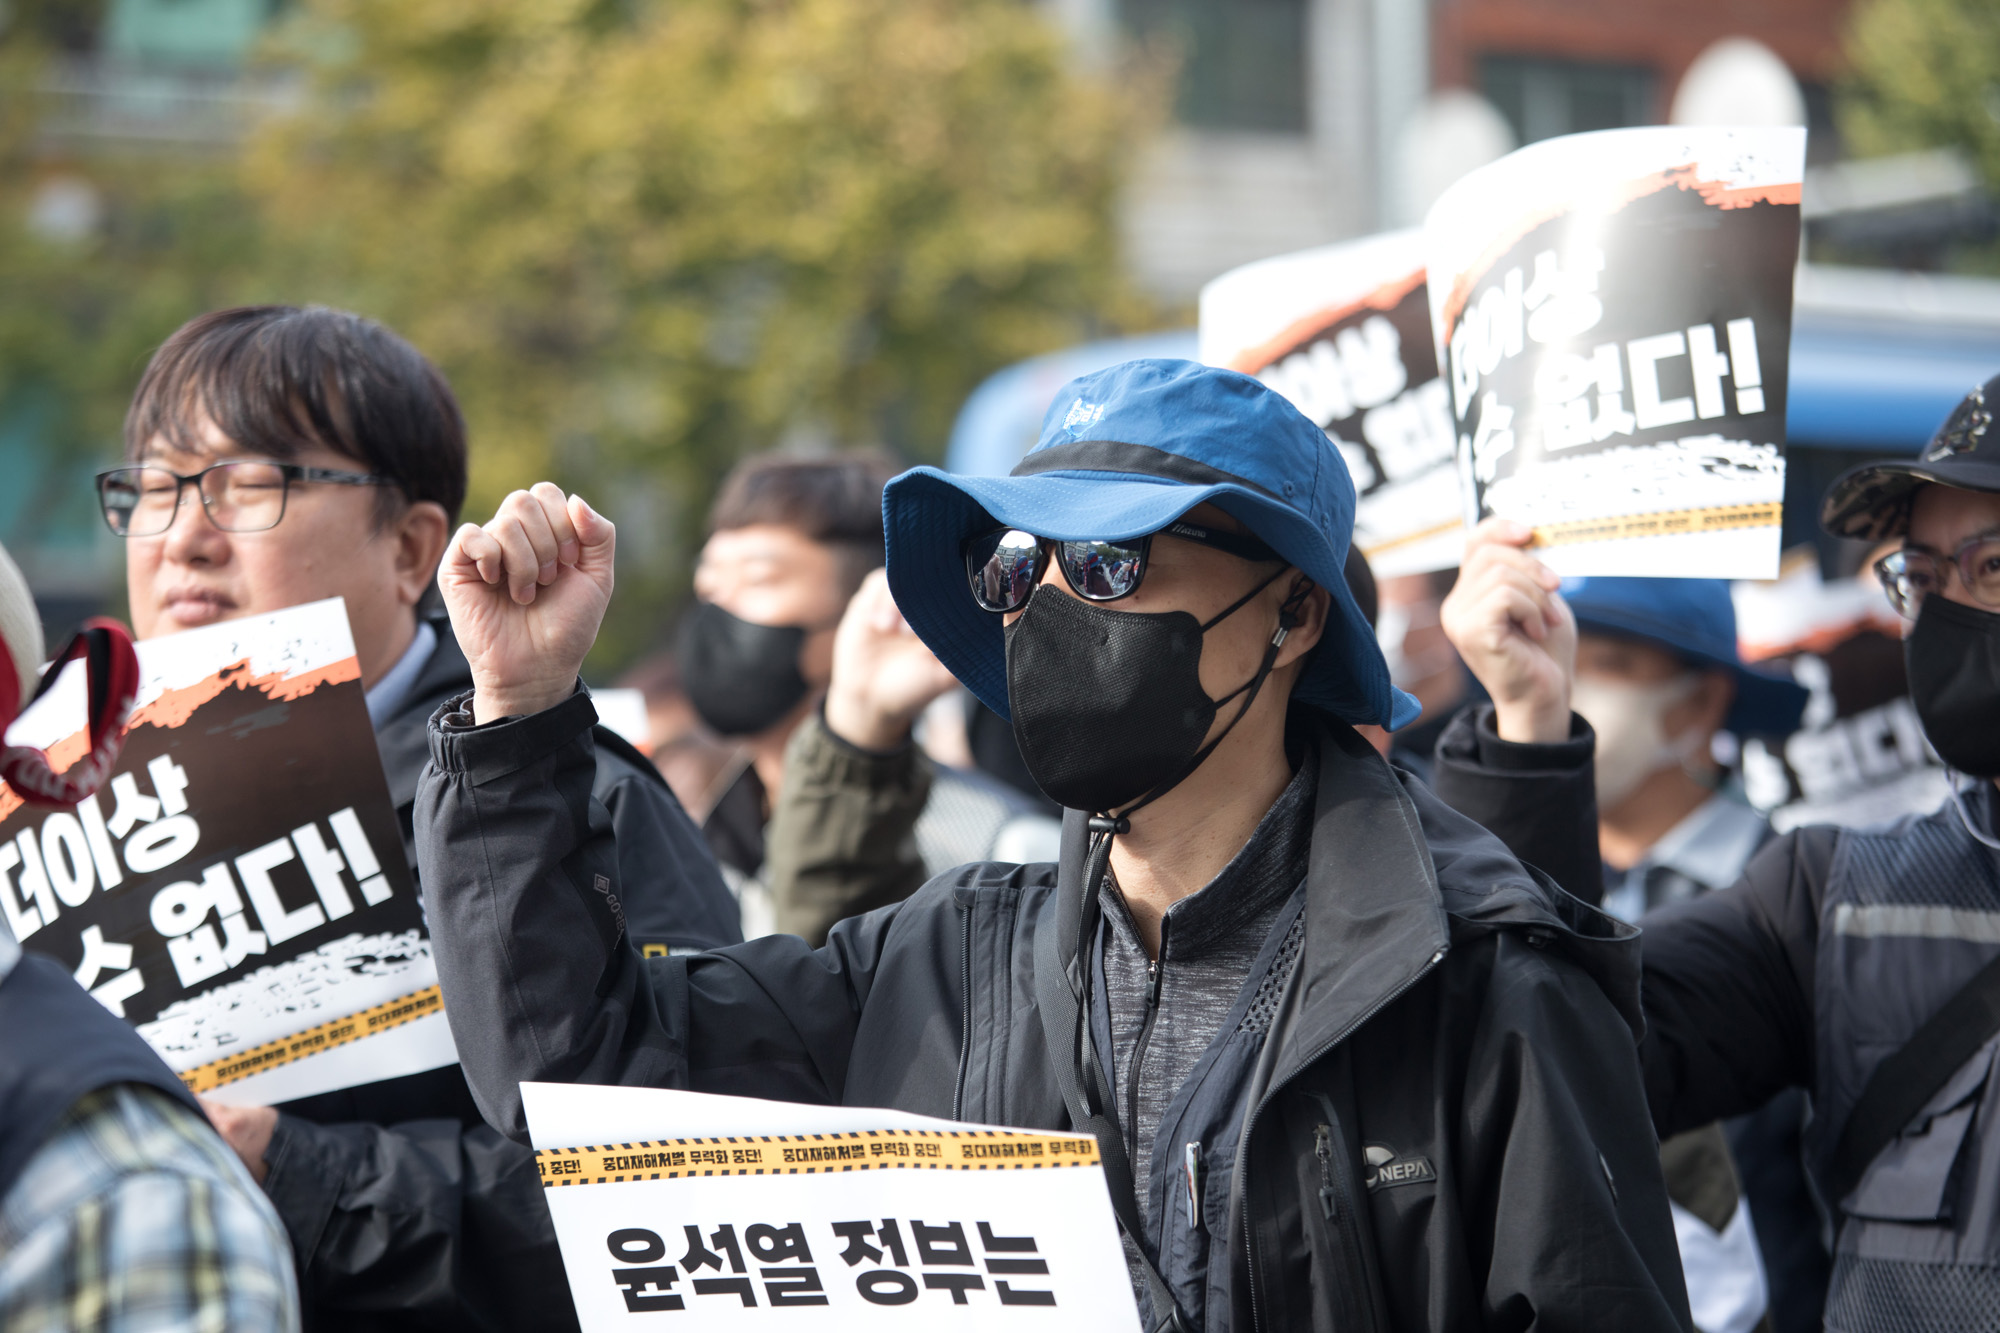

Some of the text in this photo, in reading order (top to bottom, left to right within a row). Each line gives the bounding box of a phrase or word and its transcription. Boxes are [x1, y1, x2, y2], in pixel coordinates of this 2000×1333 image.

[1534, 317, 1765, 451] 없다!
[0, 754, 200, 943] 더이상
[150, 807, 393, 988] 없다!
[550, 1159, 582, 1175] 중단!
[602, 1151, 686, 1172] 중대재해처벌
[690, 1150, 728, 1165] 무력화
[732, 1149, 763, 1164] 중단!
[783, 1144, 865, 1163] 중대재해처벌
[870, 1142, 910, 1158] 무력화
[913, 1143, 942, 1158] 중단!
[961, 1142, 1044, 1159] 중대재해처벌
[1049, 1140, 1092, 1156] 무력화
[1379, 1161, 1428, 1182] NEPA
[607, 1218, 1057, 1313] 윤석열 정부는
